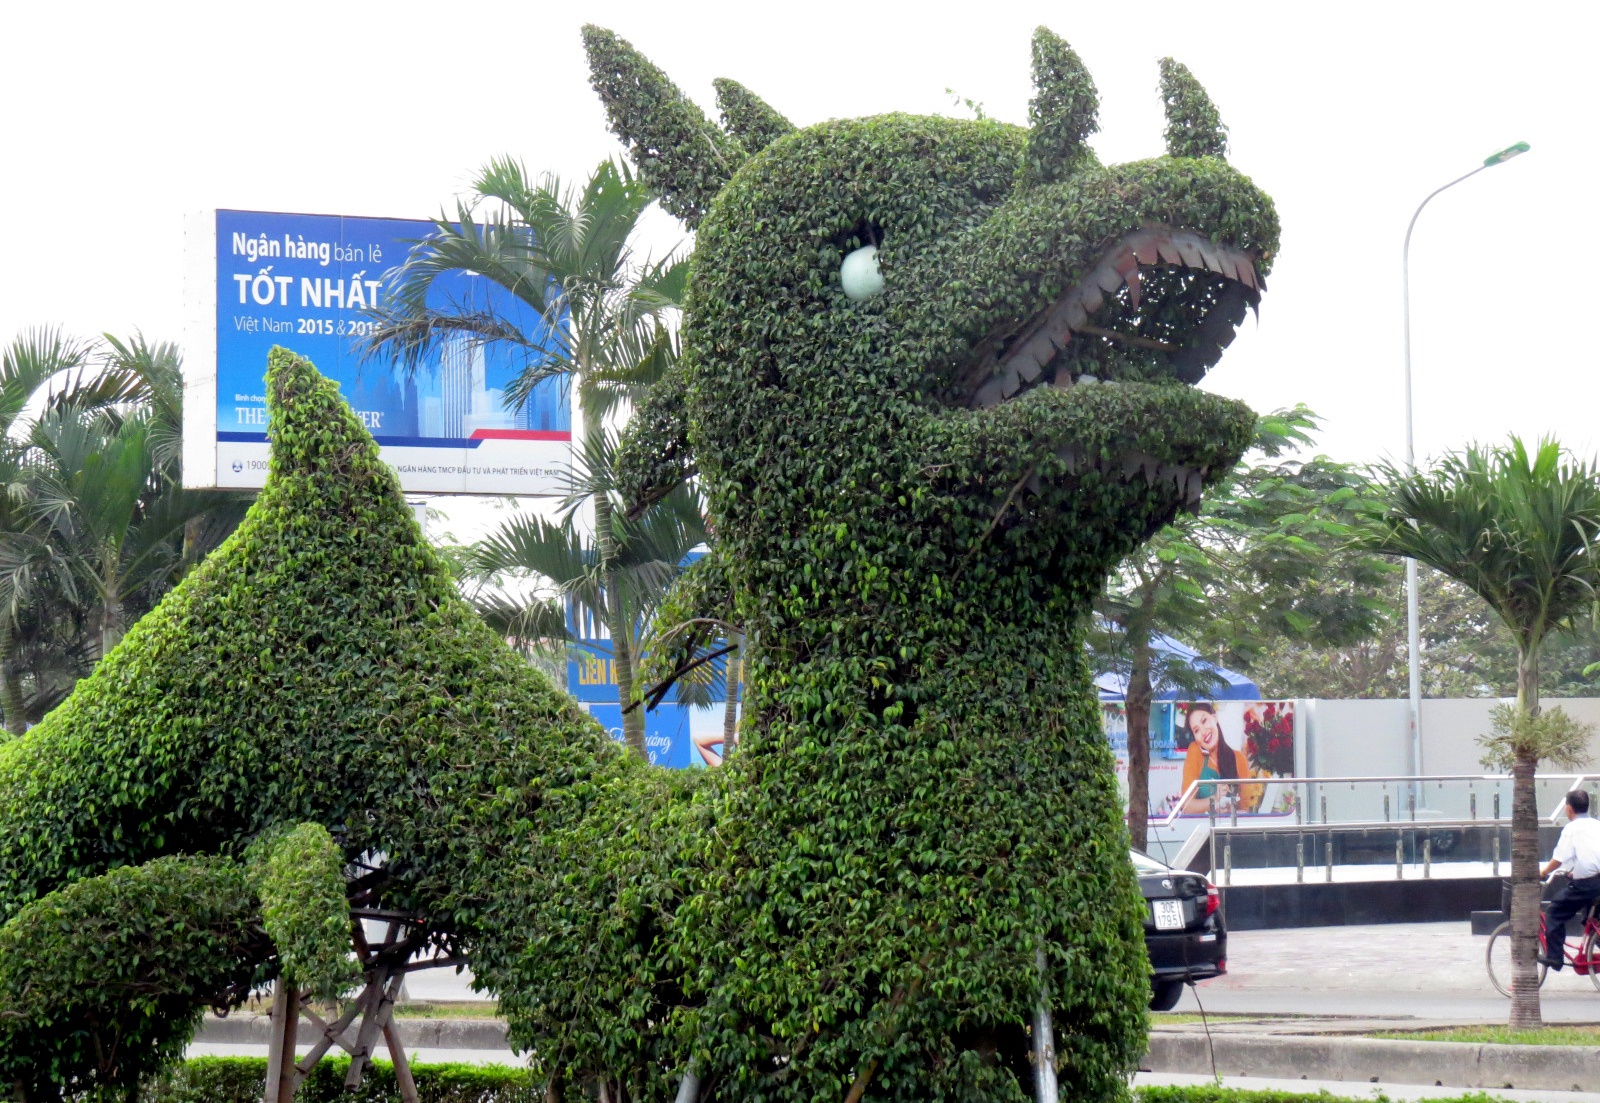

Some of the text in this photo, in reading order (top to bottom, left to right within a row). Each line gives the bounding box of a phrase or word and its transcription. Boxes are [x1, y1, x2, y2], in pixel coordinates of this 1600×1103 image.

[232, 232, 382, 266] Ngân hàng bán lẻ
[233, 265, 382, 310] TỐT NHẤT
[234, 316, 259, 334] Việt
[262, 317, 293, 333] Nam
[297, 318, 334, 335] 2015
[336, 319, 346, 335] &
[235, 407, 266, 425] THE
[397, 465, 417, 473] NGÂN
[418, 465, 437, 474] HÀNG
[438, 466, 456, 474] TMCP
[483, 465, 492, 475] VÀ
[1160, 901, 1176, 914] 30E
